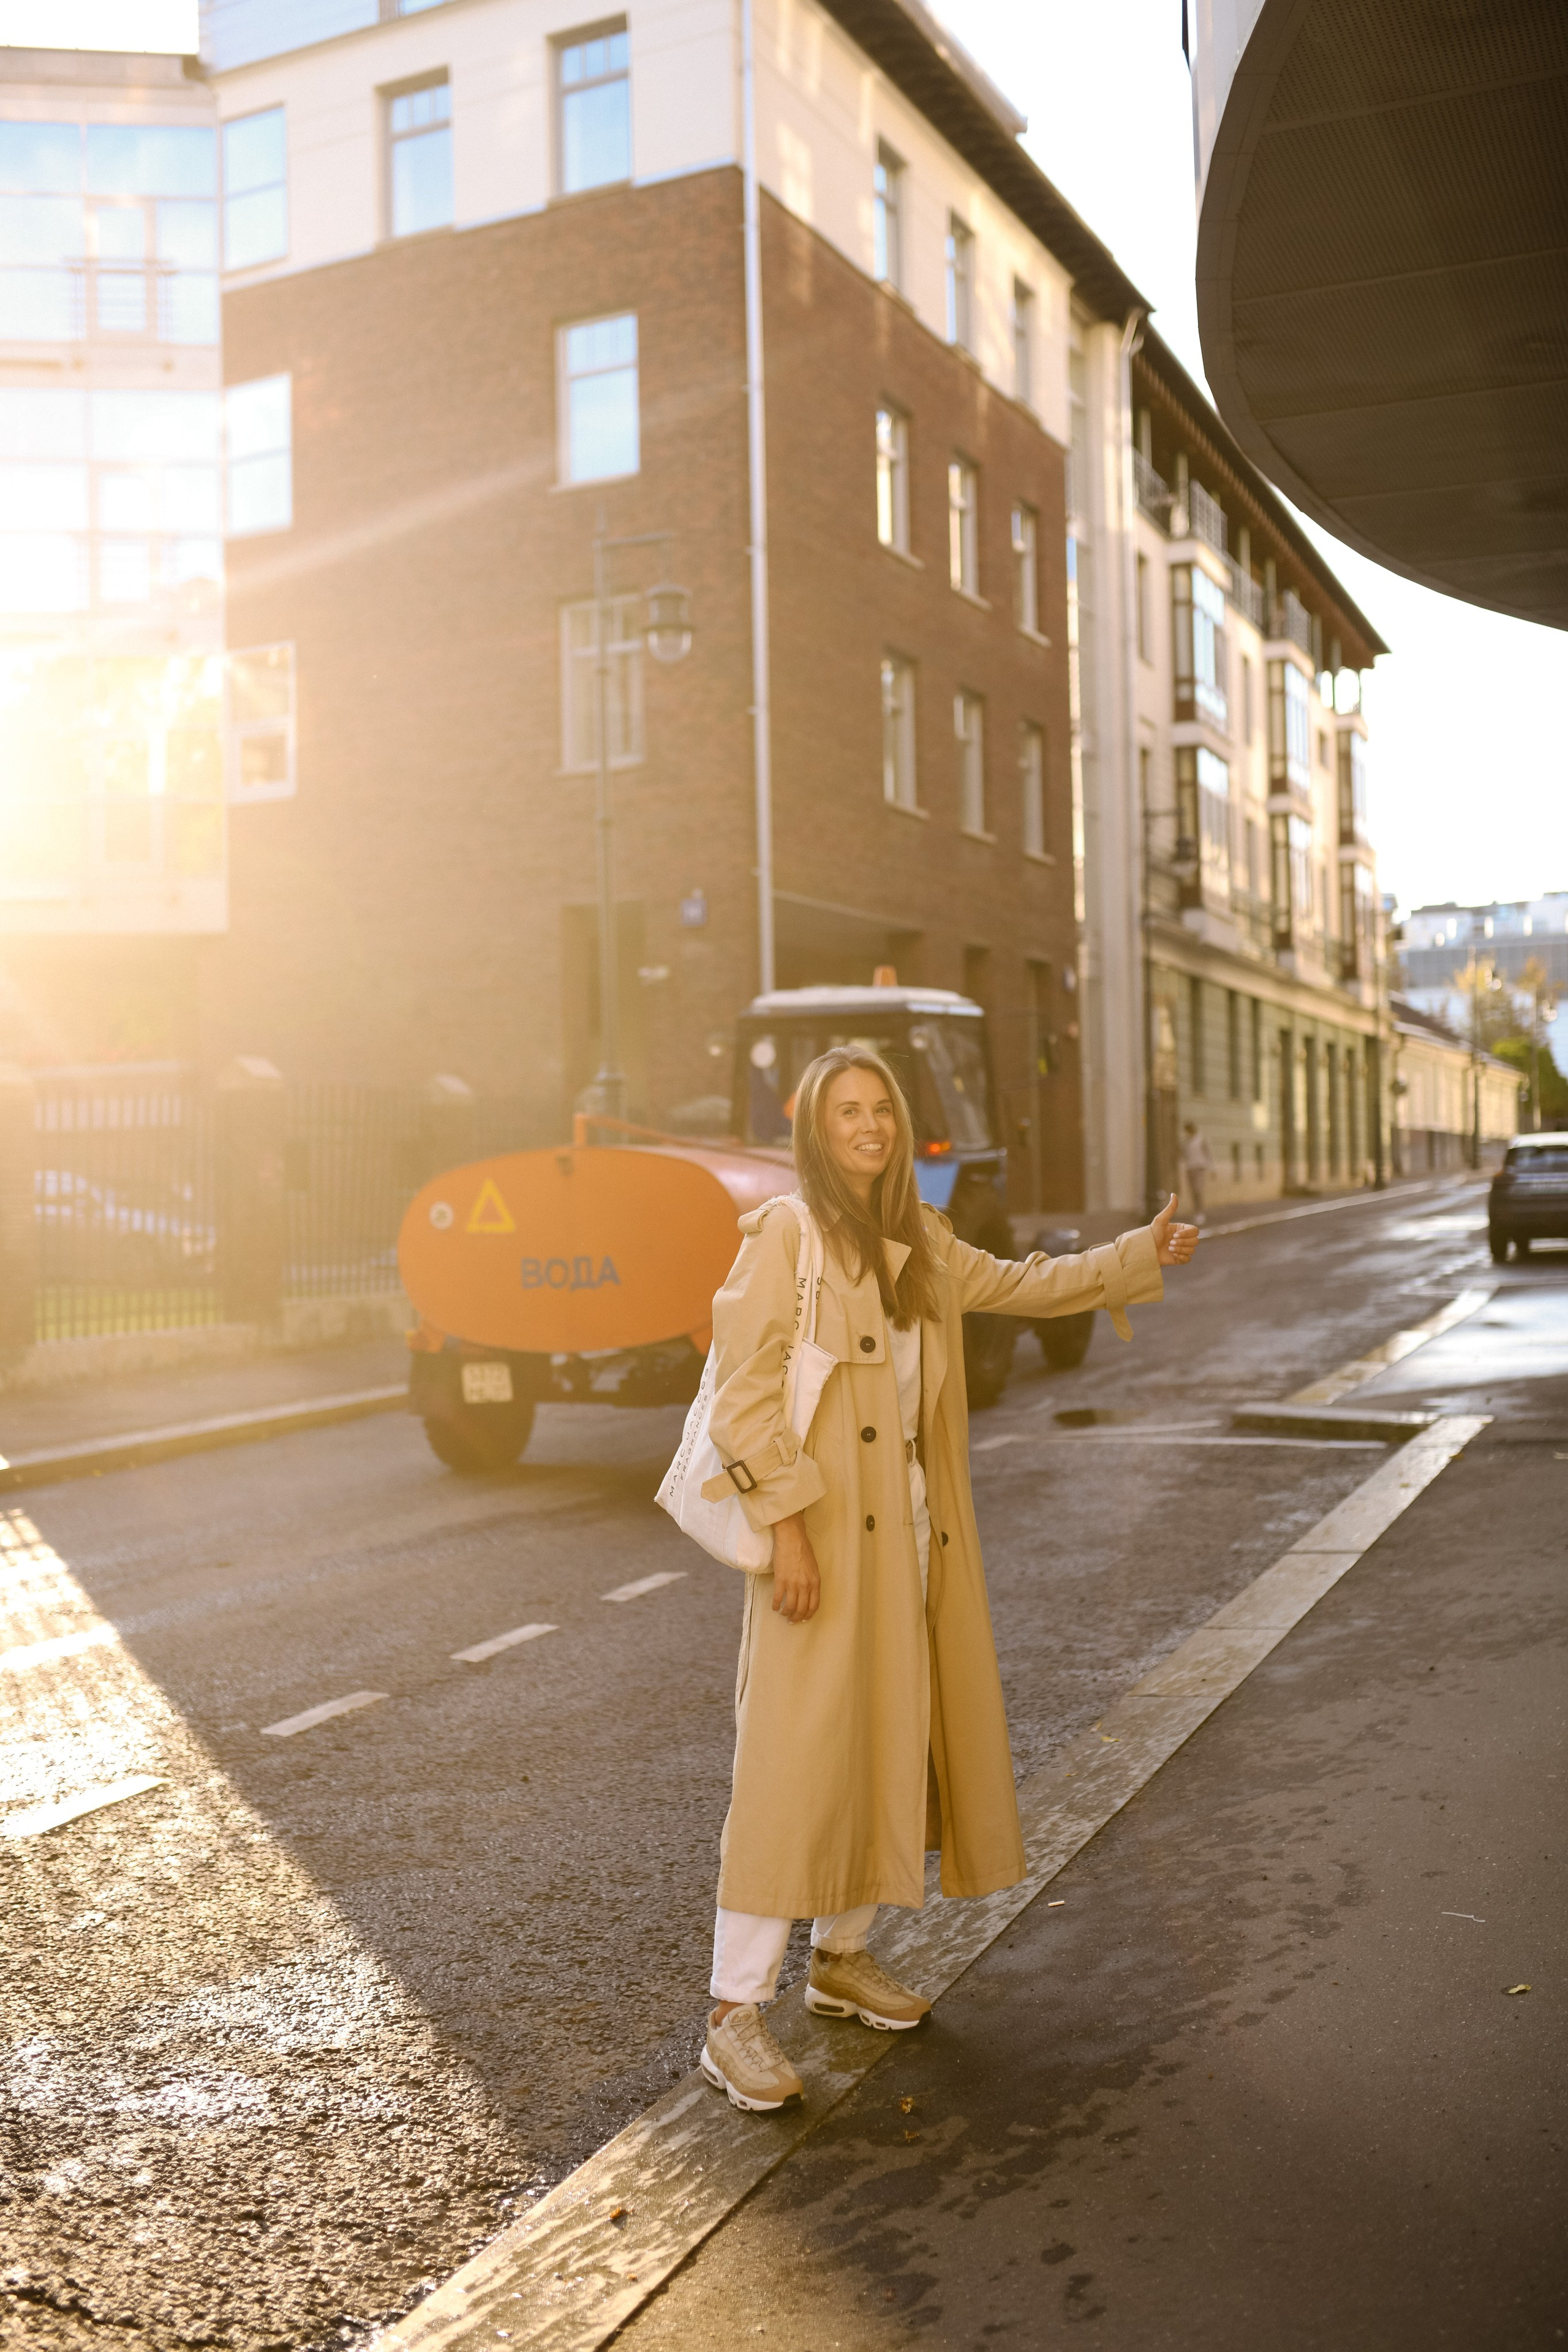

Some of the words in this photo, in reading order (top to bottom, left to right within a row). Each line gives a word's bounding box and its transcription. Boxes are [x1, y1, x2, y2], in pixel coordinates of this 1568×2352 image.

[521, 1256, 622, 1292] ВОДА
[669, 1448, 685, 1498] MARC
[686, 1368, 709, 1441] JACOBS
[680, 1395, 708, 1481] FRAGRANCES
